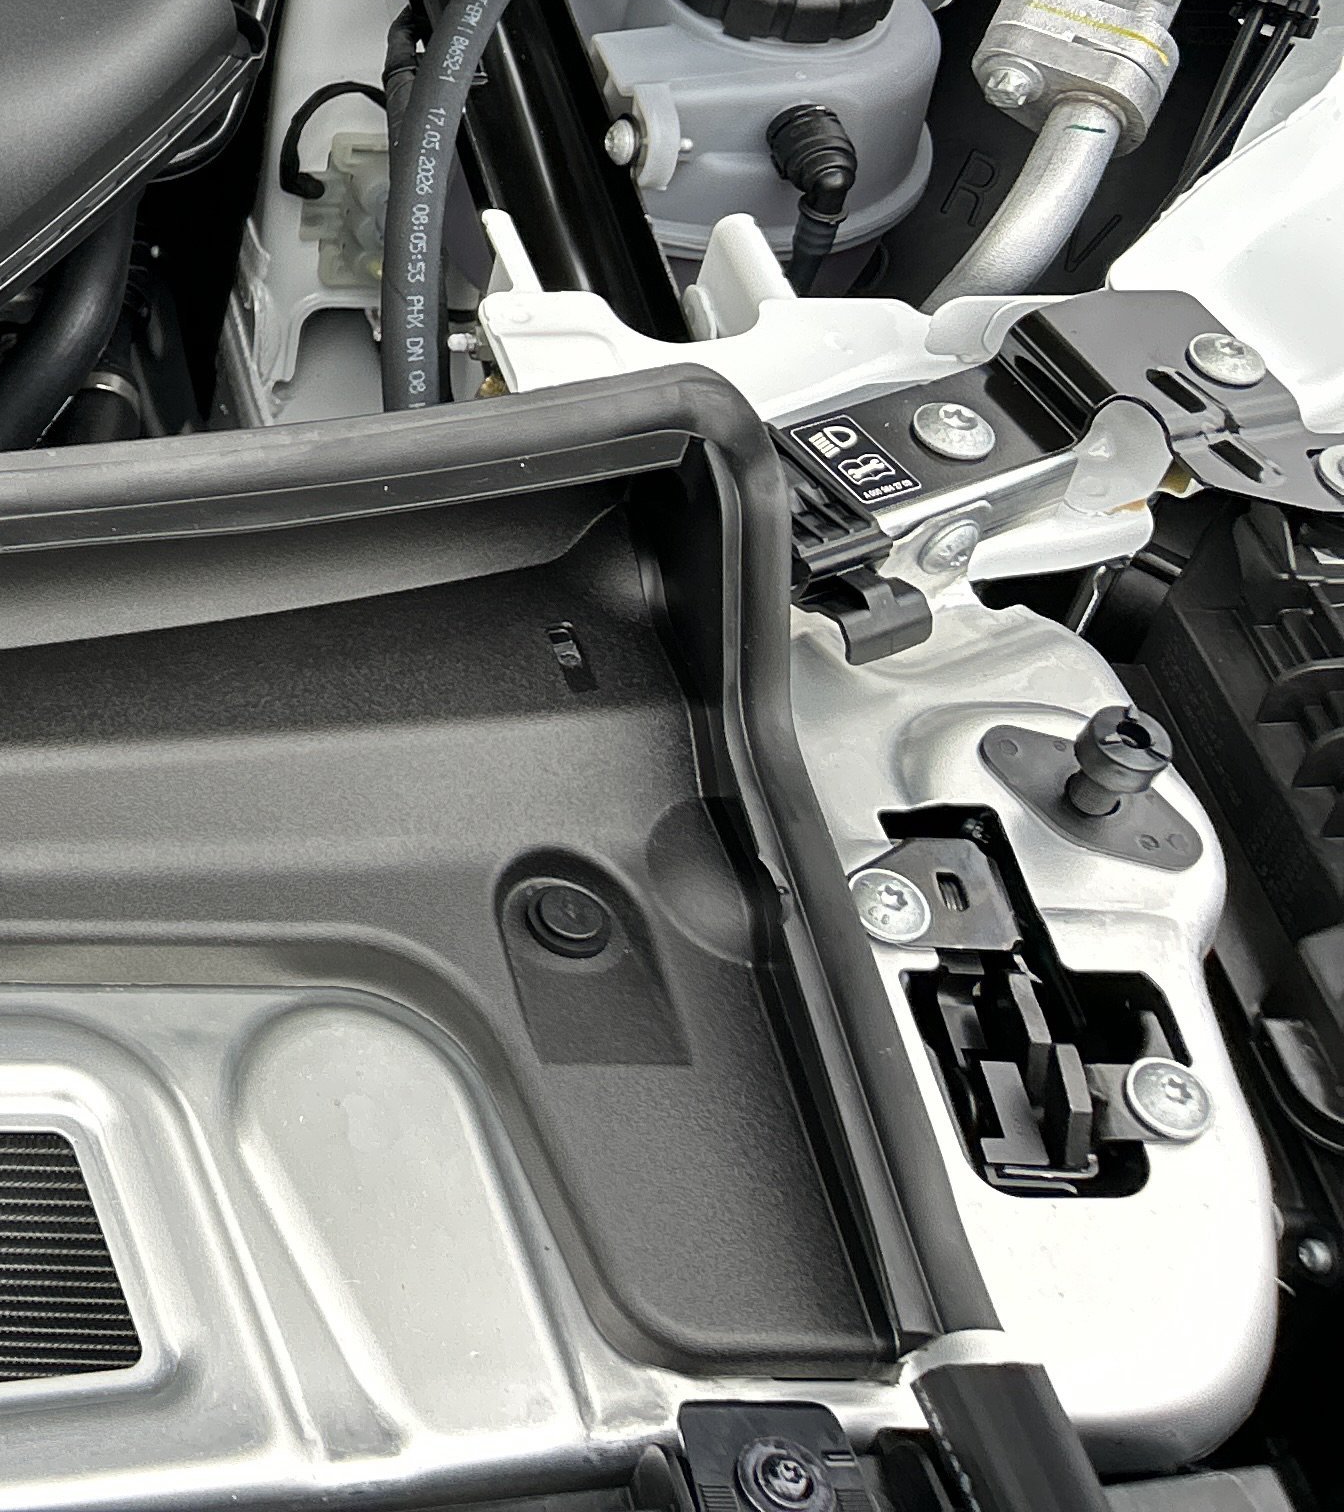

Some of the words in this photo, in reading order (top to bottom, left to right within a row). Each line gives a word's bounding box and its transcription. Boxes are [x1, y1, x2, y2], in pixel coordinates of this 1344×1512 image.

[407, 203, 430, 284] 08:05:53
[406, 294, 425, 329] PHX
[406, 337, 425, 362] DN
[408, 370, 426, 395] 08
